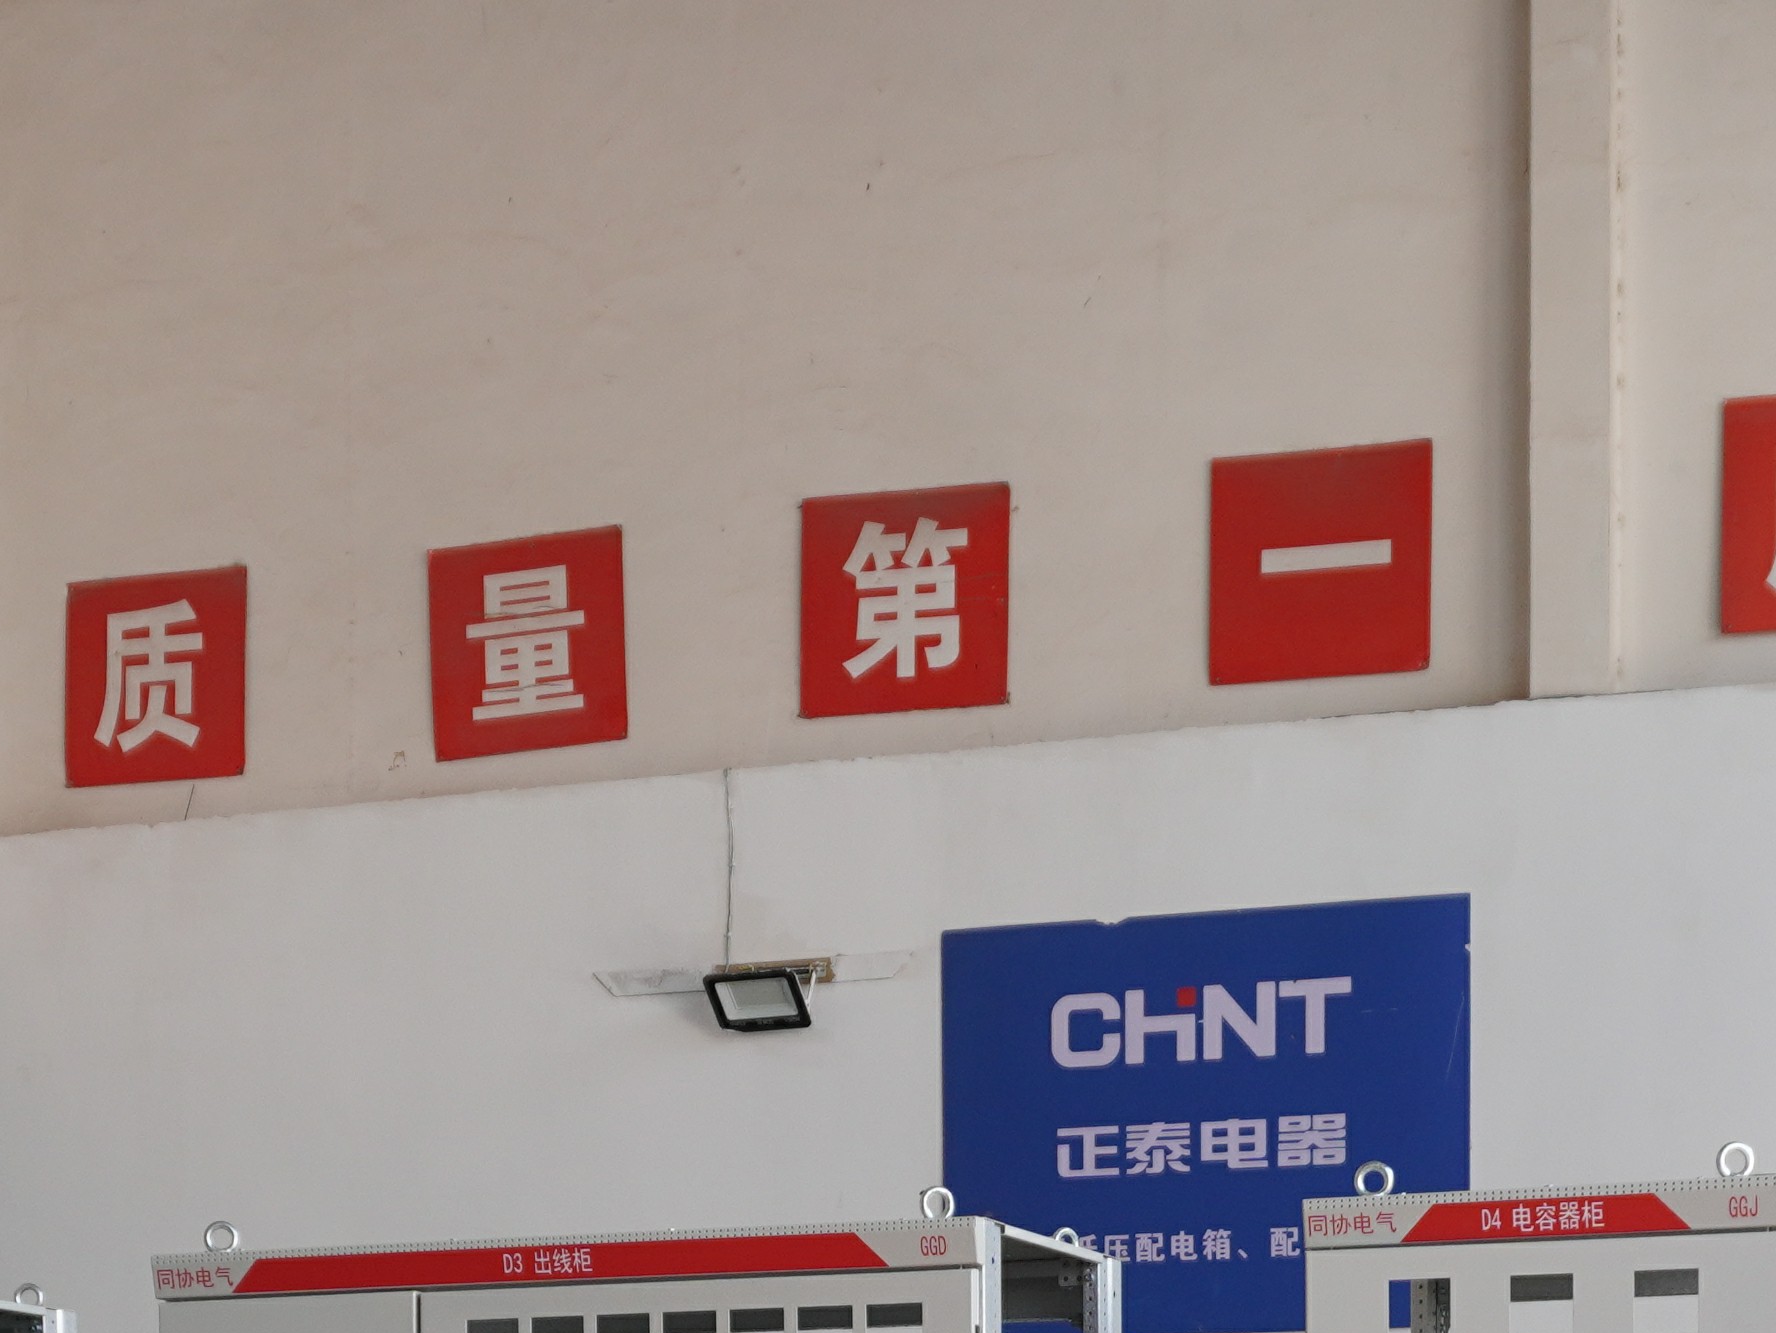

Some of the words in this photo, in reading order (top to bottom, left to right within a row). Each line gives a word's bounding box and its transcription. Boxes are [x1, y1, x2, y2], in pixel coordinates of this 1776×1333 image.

[1056, 1113, 1348, 1178] 正泰电器
[1480, 1207, 1502, 1232] D4
[1511, 1198, 1606, 1234] 电容器柜
[1728, 1195, 1761, 1220] GGJ
[1307, 1211, 1398, 1239] 同协电气
[919, 1234, 949, 1258] GGD
[501, 1251, 524, 1274] D3
[533, 1246, 594, 1277] 出线柜
[155, 1265, 234, 1290] 同协电气
